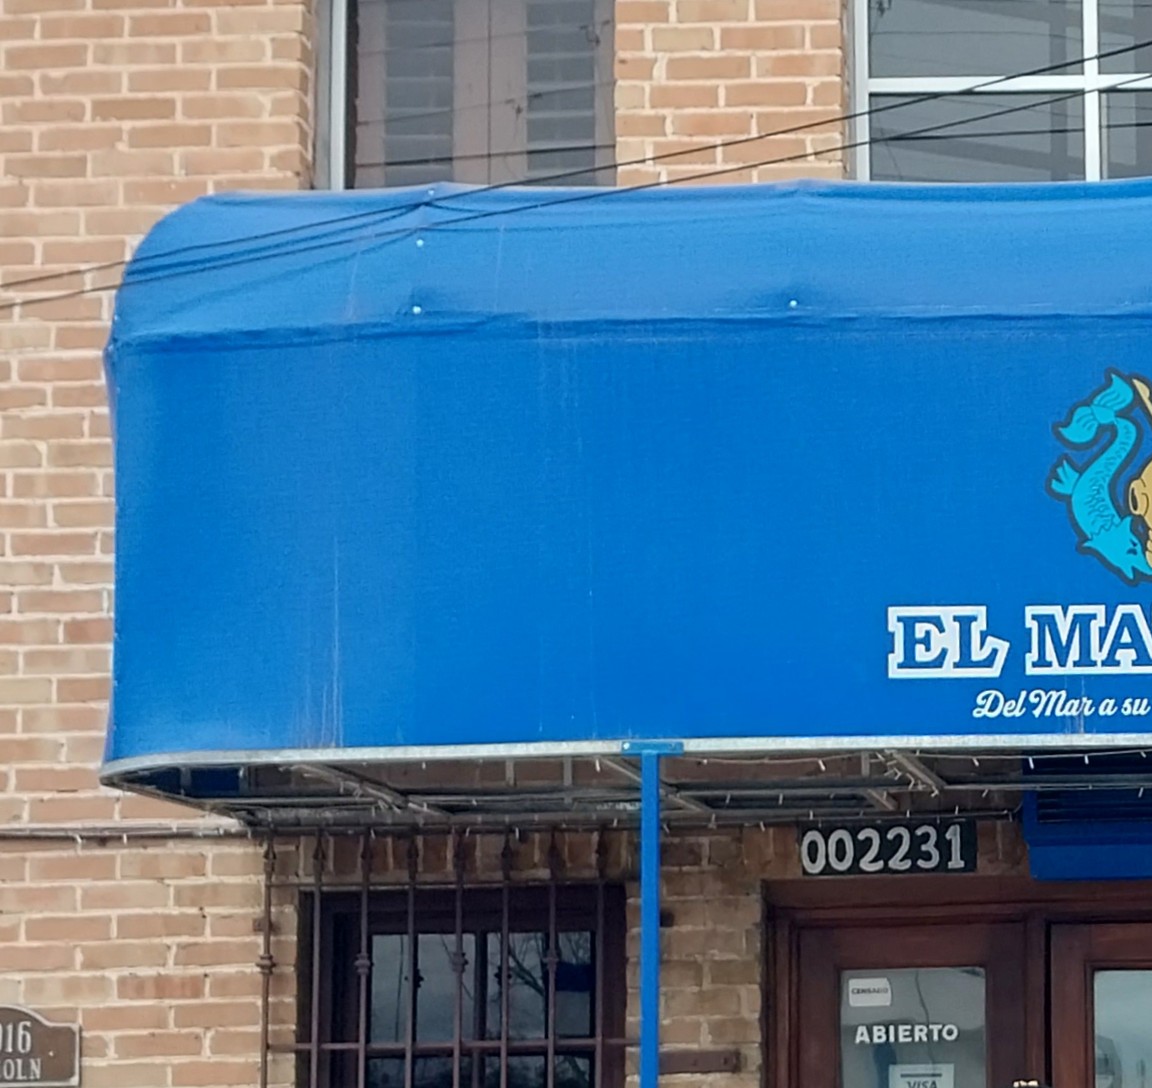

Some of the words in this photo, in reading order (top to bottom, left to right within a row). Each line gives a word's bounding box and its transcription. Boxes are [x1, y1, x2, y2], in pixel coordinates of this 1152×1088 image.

[887, 606, 1010, 678] EL
[972, 689, 1026, 718] Del
[1028, 688, 1095, 717] Mar
[1096, 696, 1116, 715] a
[1121, 696, 1151, 716] su
[801, 824, 965, 874] 002231
[0, 1020, 32, 1054] 16
[855, 1024, 959, 1044] ABIERTO
[0, 1058, 41, 1081] OLN
